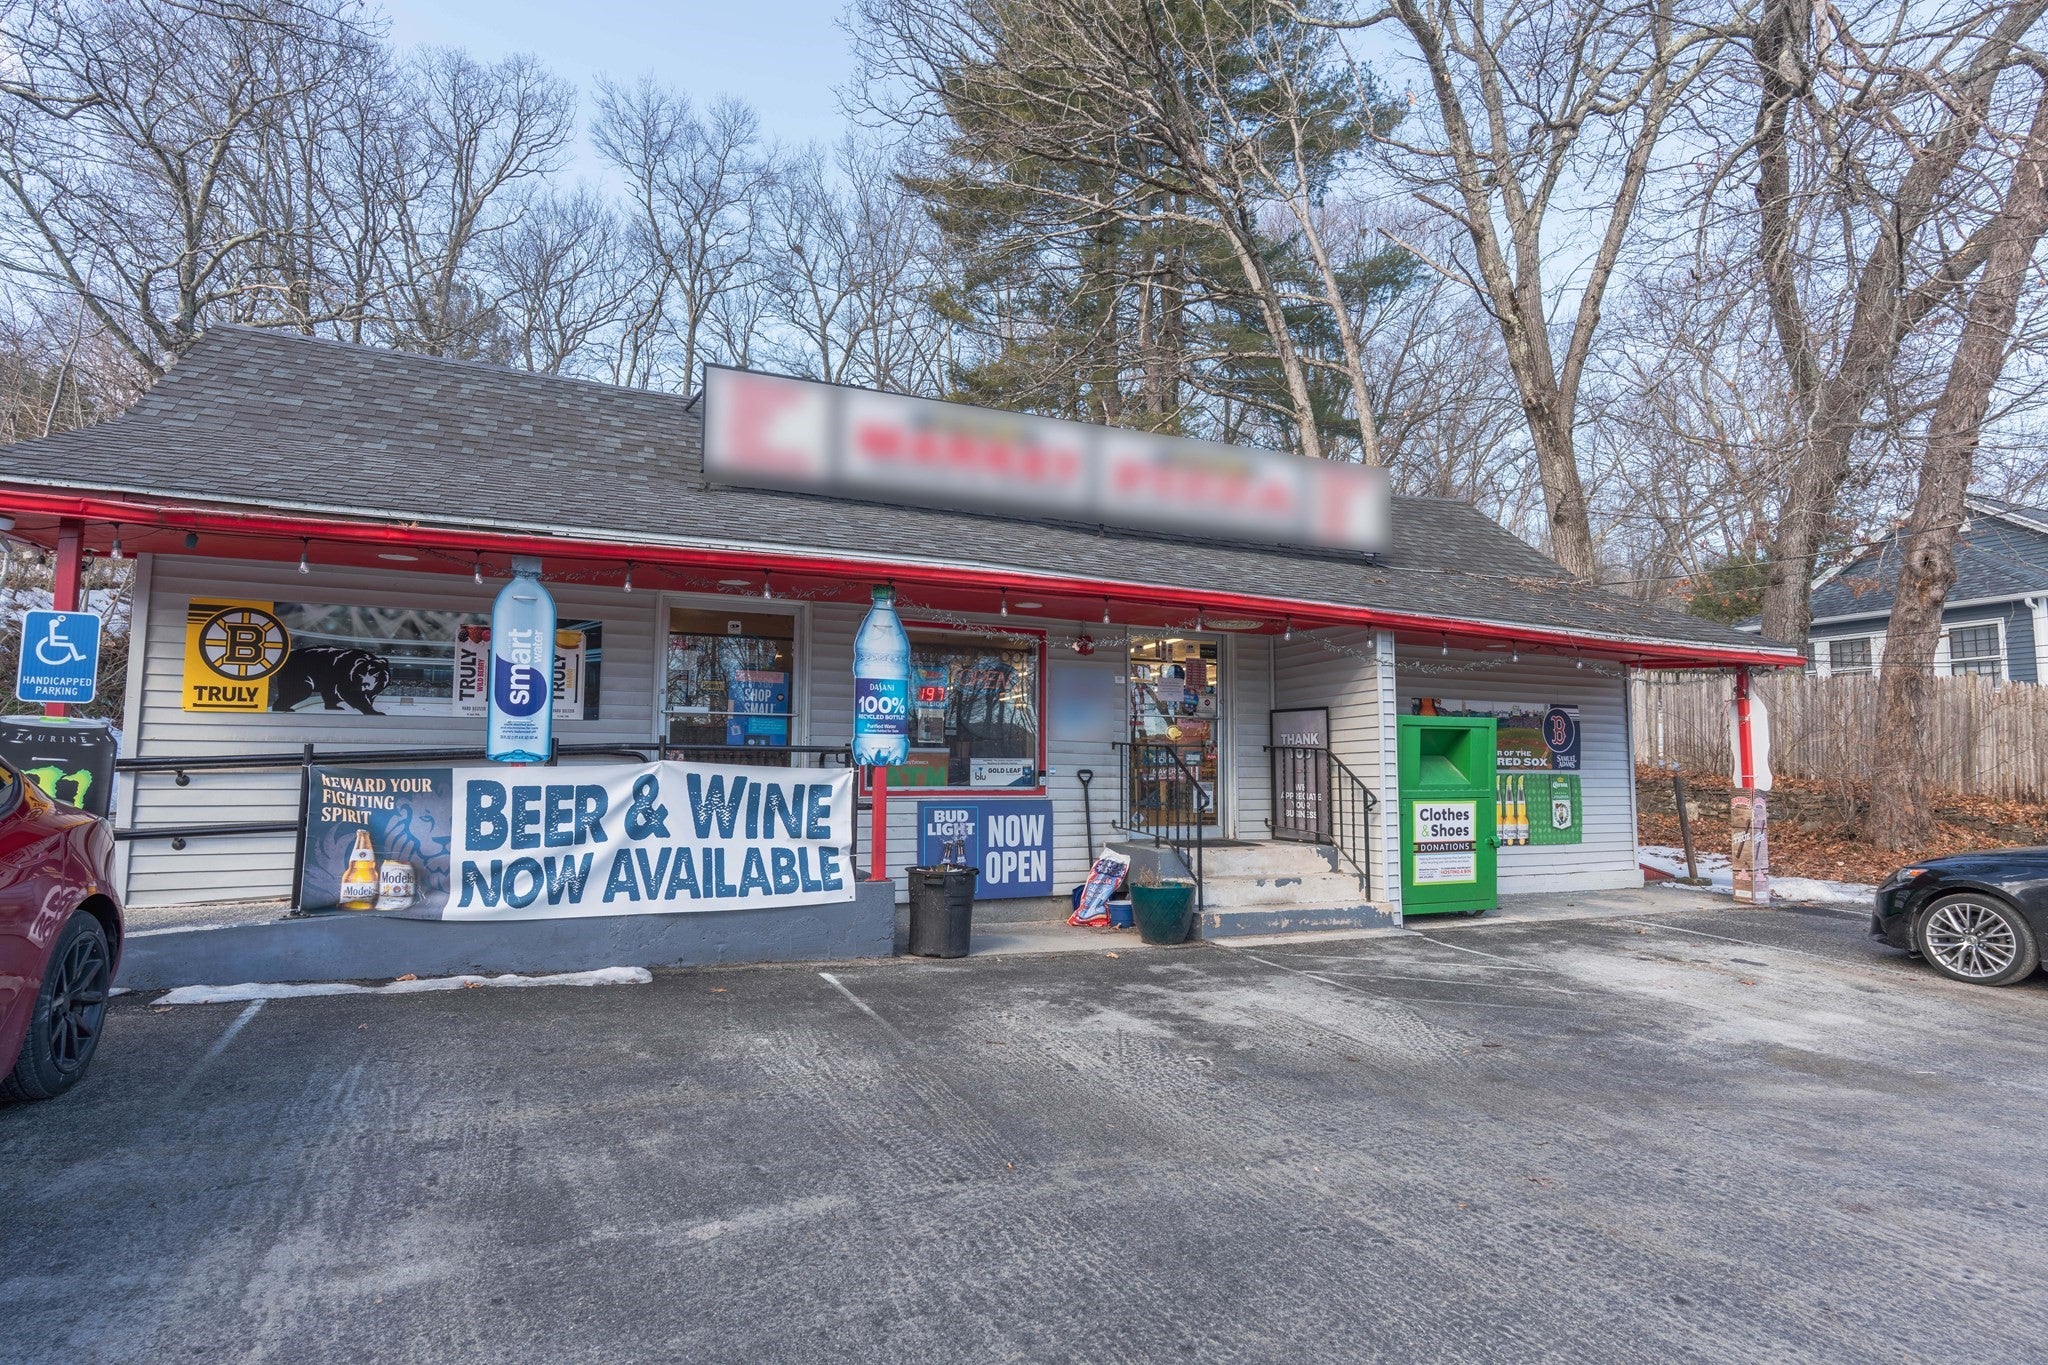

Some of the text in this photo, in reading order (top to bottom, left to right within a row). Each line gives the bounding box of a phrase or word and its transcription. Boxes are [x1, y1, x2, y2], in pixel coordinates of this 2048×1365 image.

[533, 630, 543, 663] water
[508, 628, 532, 705] smart
[22, 676, 92, 686] HANDICAPPED
[459, 648, 477, 701] TRULY
[476, 659, 485, 692] WILD BERRY
[959, 669, 1010, 689] OPEN
[35, 686, 78, 696] PARKING
[193, 685, 259, 702] TRULY
[869, 683, 895, 691] DASANI
[921, 687, 945, 701] 197
[744, 689, 772, 702] SHOP
[744, 702, 774, 715] SMALL
[858, 695, 905, 714] 100%
[16, 732, 87, 744] TAURINE
[1280, 733, 1319, 745] THANK
[1497, 758, 1548, 766] RED SOX
[321, 774, 433, 793] REWARD YOUR
[886, 766, 946, 787] ATM
[322, 788, 395, 810] FIGHTING
[320, 807, 372, 825] SPIRIT
[465, 773, 833, 852] BEER & WINE
[934, 810, 969, 823] BUD
[1419, 808, 1470, 822] Clothes
[927, 822, 975, 836] LIGHT
[988, 814, 1045, 848] NOW
[1422, 823, 1469, 837] & Shoes
[1420, 842, 1470, 852] DONATIONS
[985, 850, 1047, 884] OPEN
[382, 871, 415, 884] Modelo
[457, 846, 843, 909] NOW AVAILABLE
[346, 884, 375, 897] Modelo
